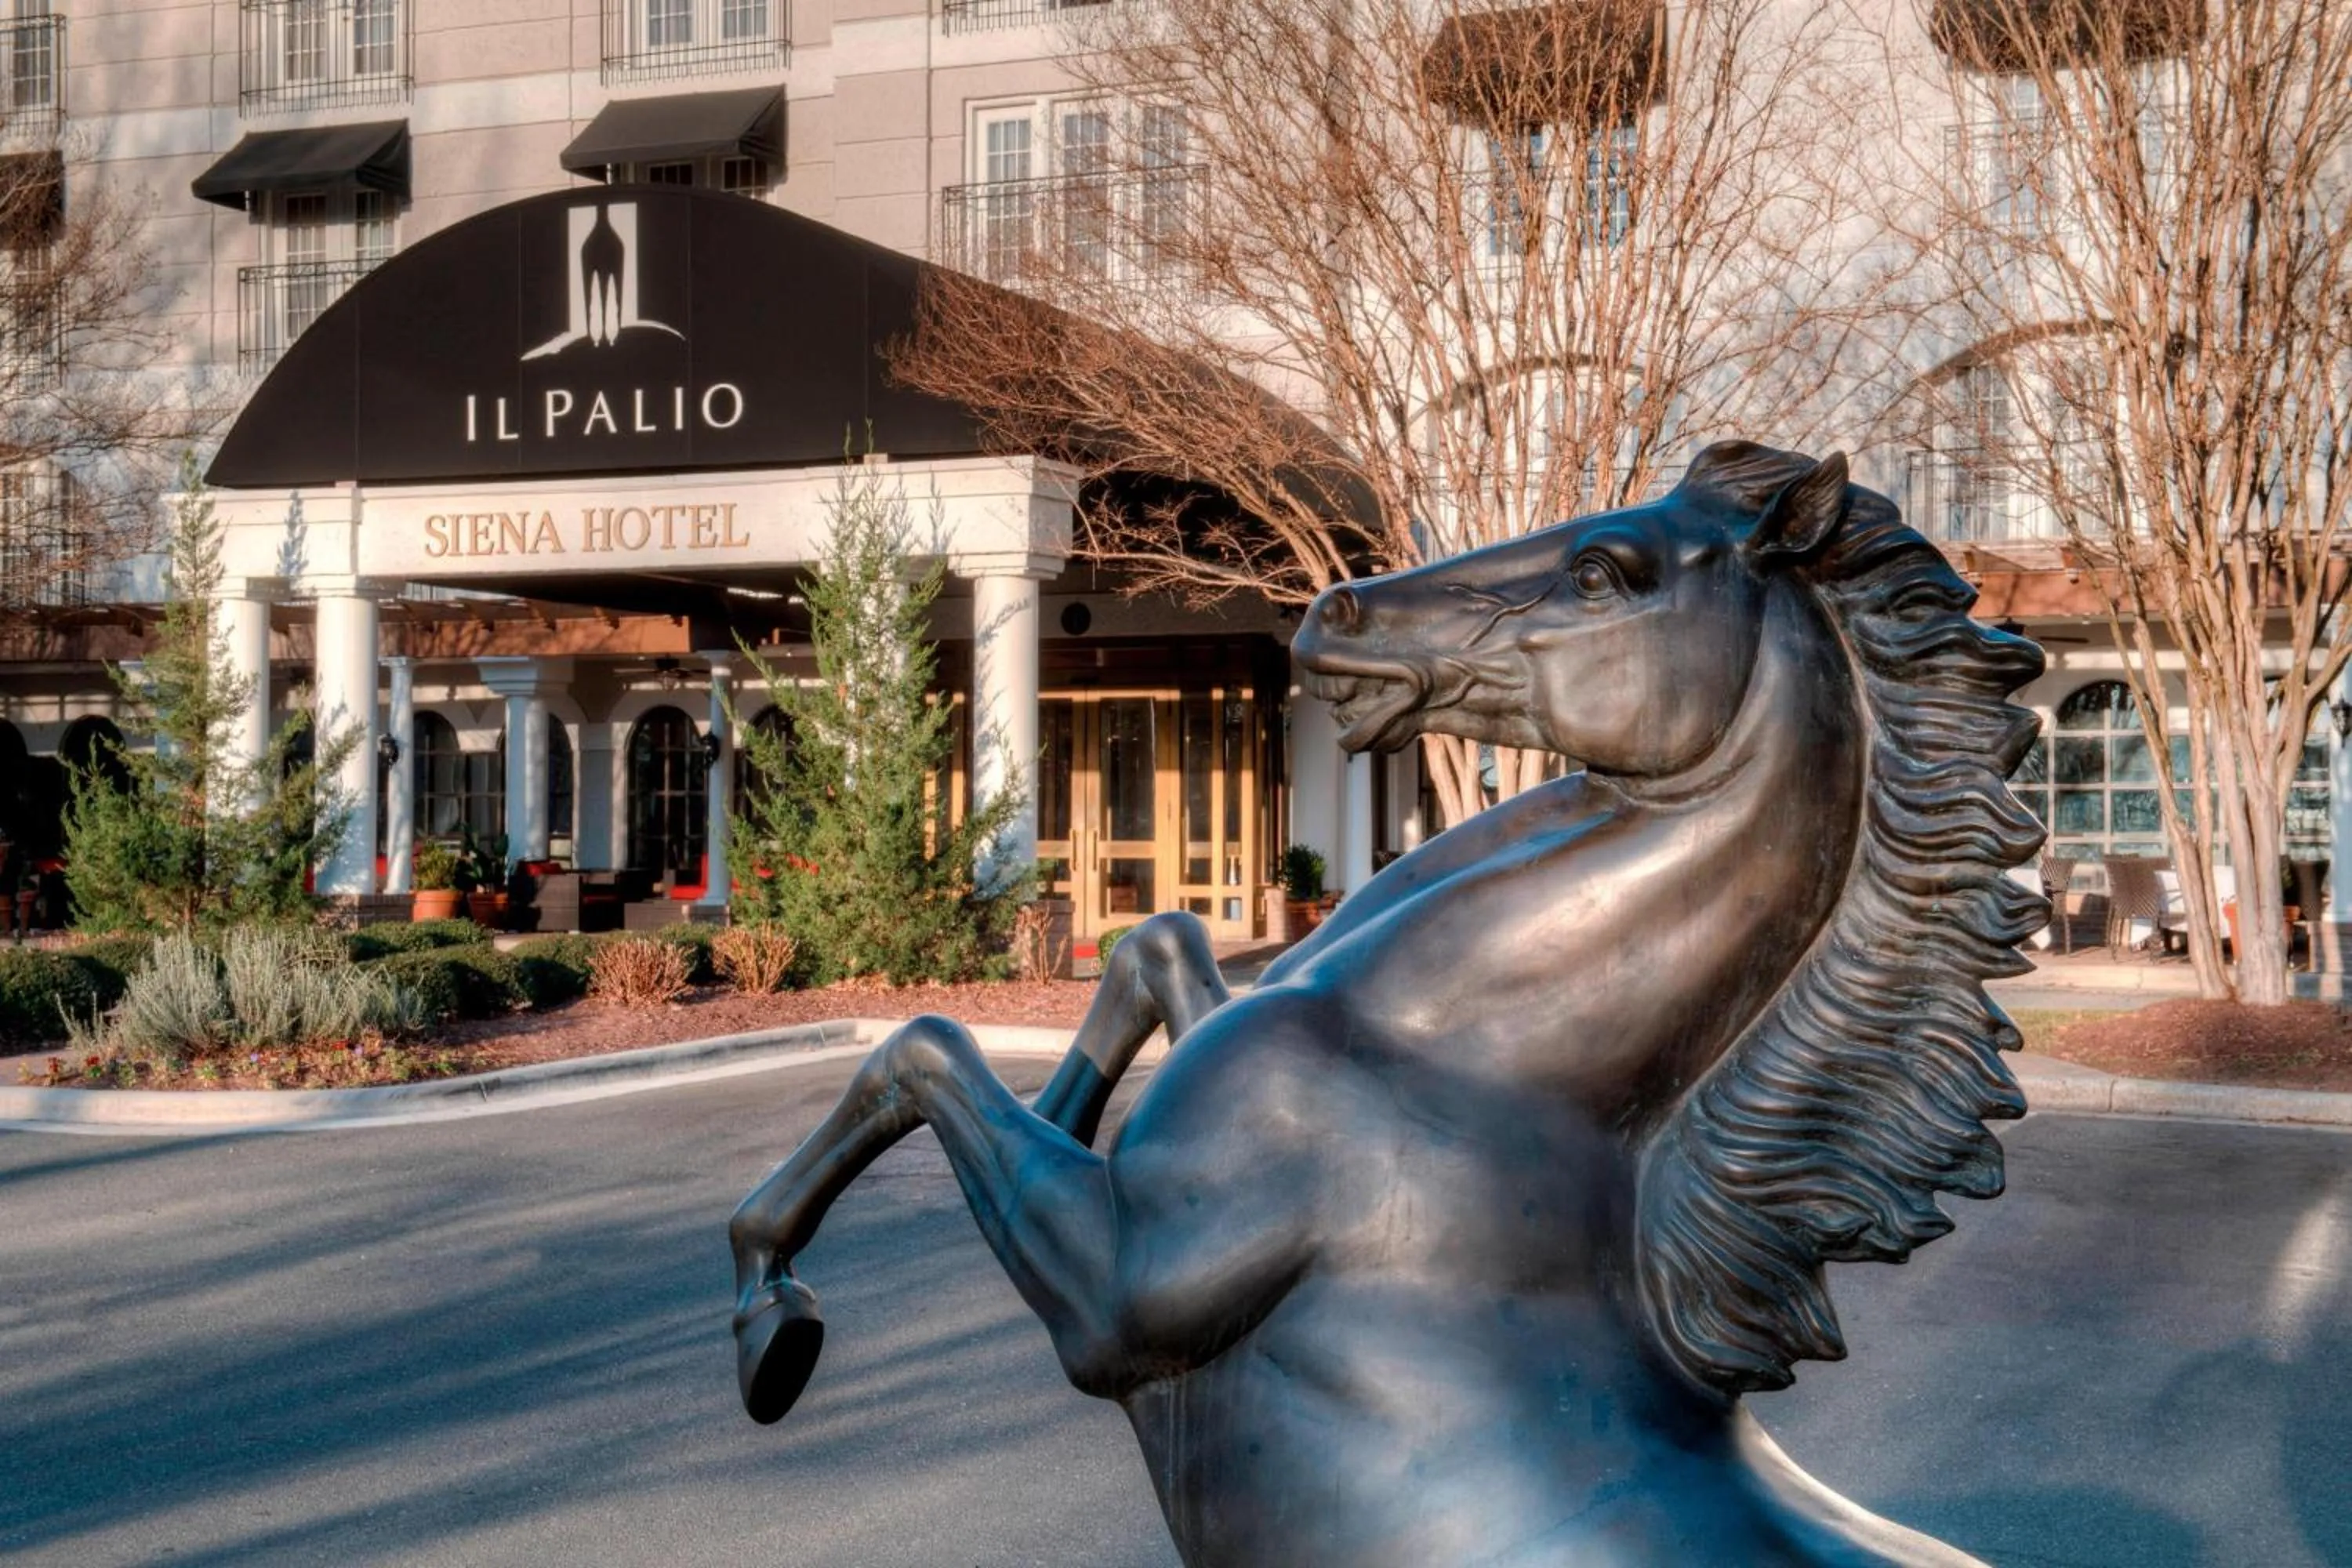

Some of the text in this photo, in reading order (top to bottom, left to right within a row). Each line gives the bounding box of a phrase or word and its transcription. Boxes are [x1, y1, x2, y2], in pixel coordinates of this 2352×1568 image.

[466, 383, 743, 441] IL PALIO
[424, 503, 750, 557] SIENA HOTEL
